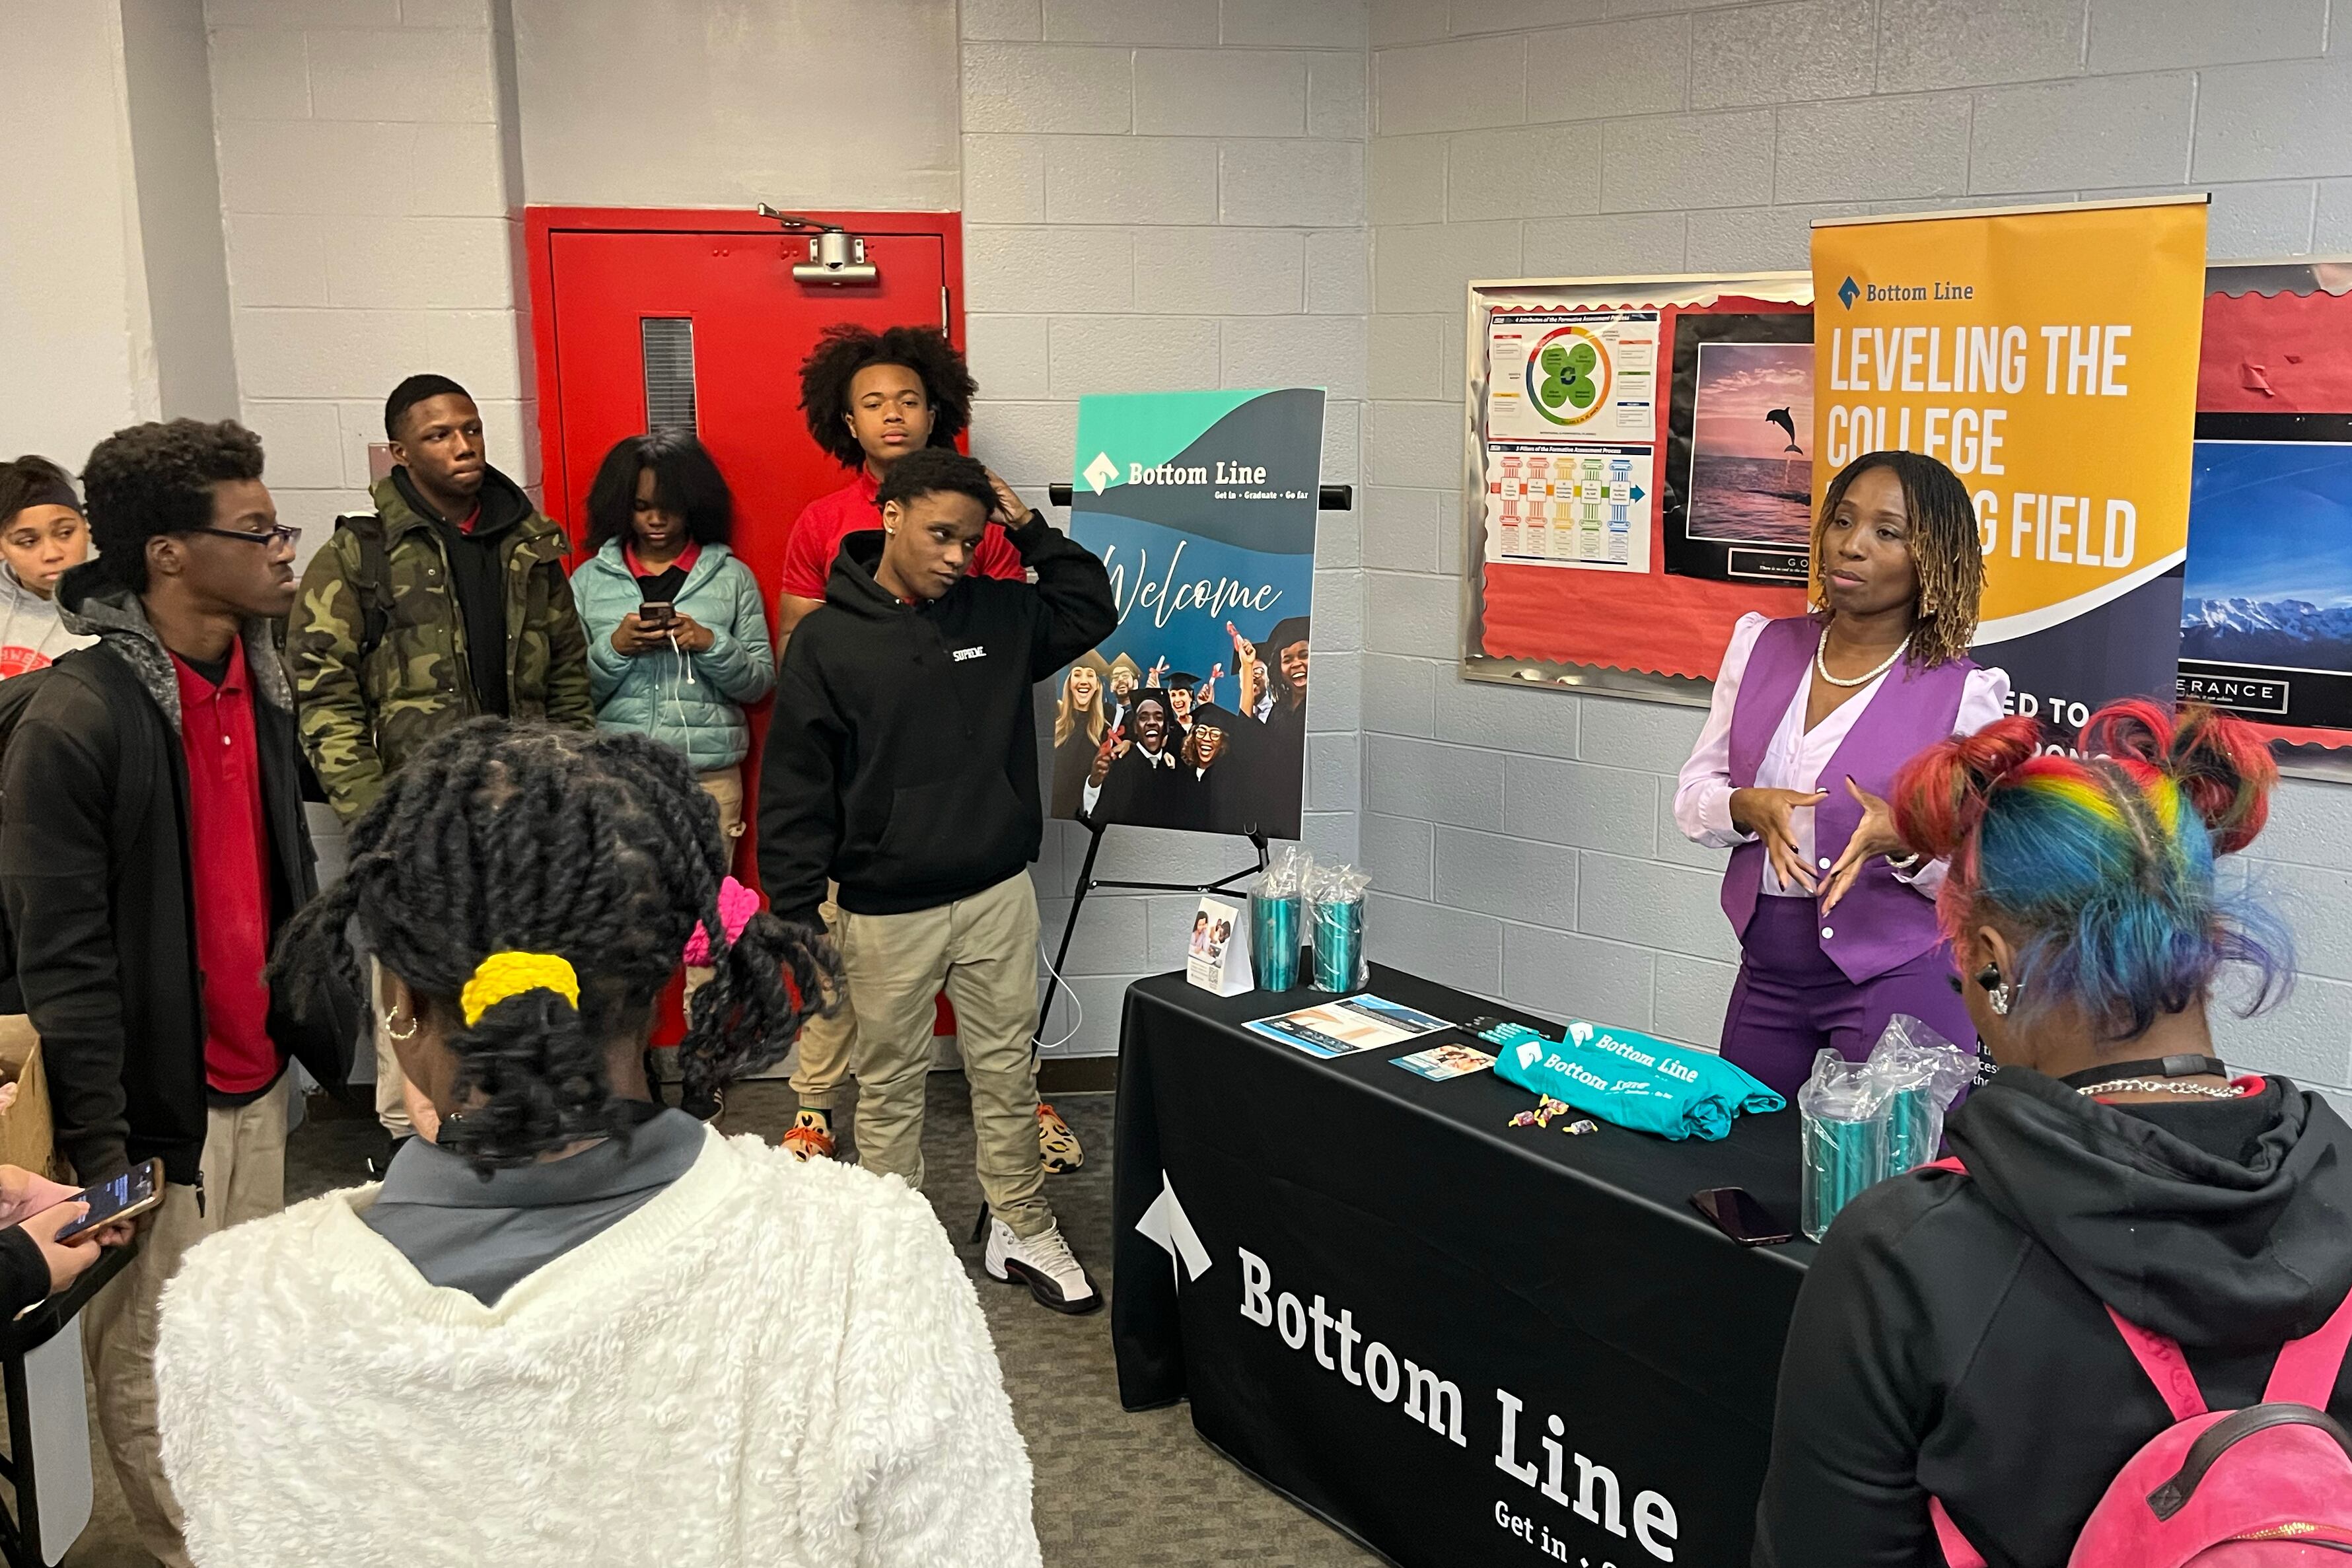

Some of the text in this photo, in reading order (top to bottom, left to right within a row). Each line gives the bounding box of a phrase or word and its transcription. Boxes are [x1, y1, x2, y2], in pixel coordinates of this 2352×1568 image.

[1867, 281, 1974, 302] Bottom Line
[1830, 326, 2131, 396] LEVELING THE
[1827, 405, 2008, 476] COLLEGE
[1128, 460, 1267, 485] Bottom Line
[1215, 491, 1227, 499] Get
[1244, 491, 1277, 499] Graduate
[1285, 491, 1296, 499] Go
[1297, 490, 1308, 499] far
[2011, 493, 2136, 569] FIELD
[1788, 558, 1809, 567] GO
[1104, 540, 1283, 629] Welcome
[2003, 690, 2090, 728] ED TO
[2176, 679, 2273, 699] ERANCE
[1543, 1053, 1609, 1091] Bottom
[1596, 1034, 1699, 1083] Bottom Line
[1237, 1246, 1679, 1563] Bottom Line
[1495, 1500, 1568, 1563] Get in
